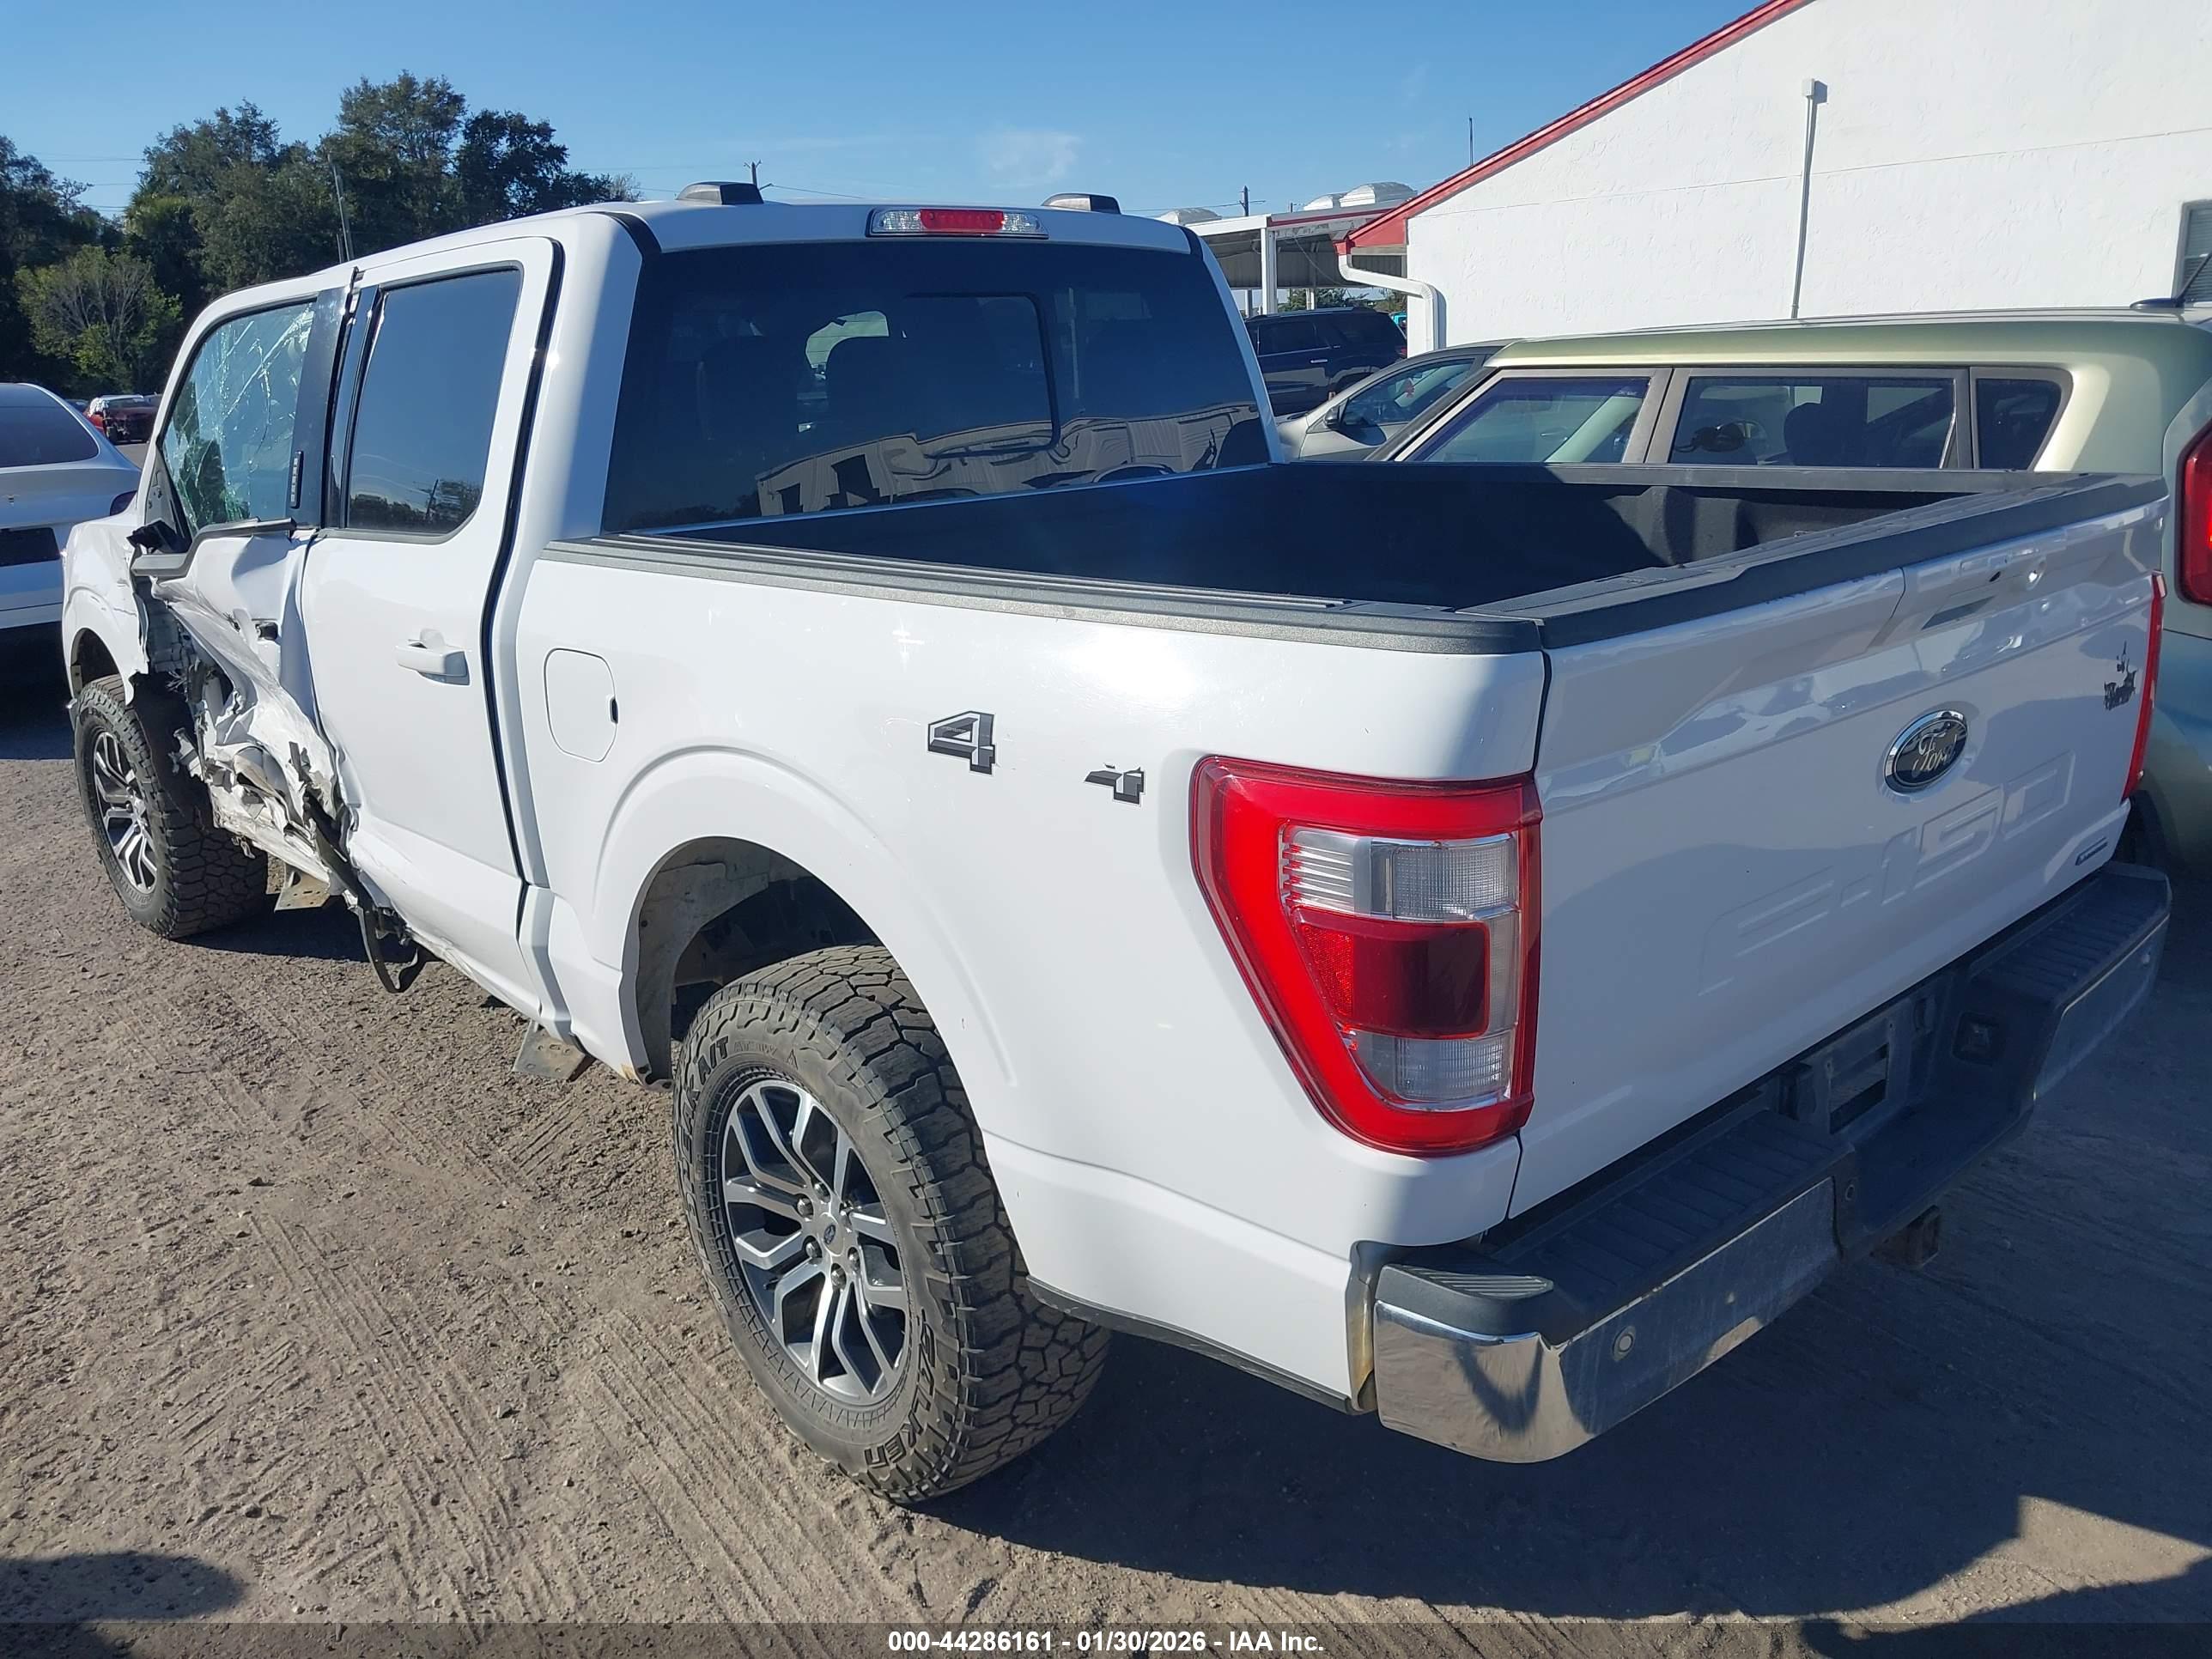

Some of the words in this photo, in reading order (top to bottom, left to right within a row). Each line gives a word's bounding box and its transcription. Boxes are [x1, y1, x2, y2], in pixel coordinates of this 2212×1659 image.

[927, 710, 996, 775] 4
[1698, 750, 2076, 996] F-150
[863, 1307, 936, 1468] FALKEN
